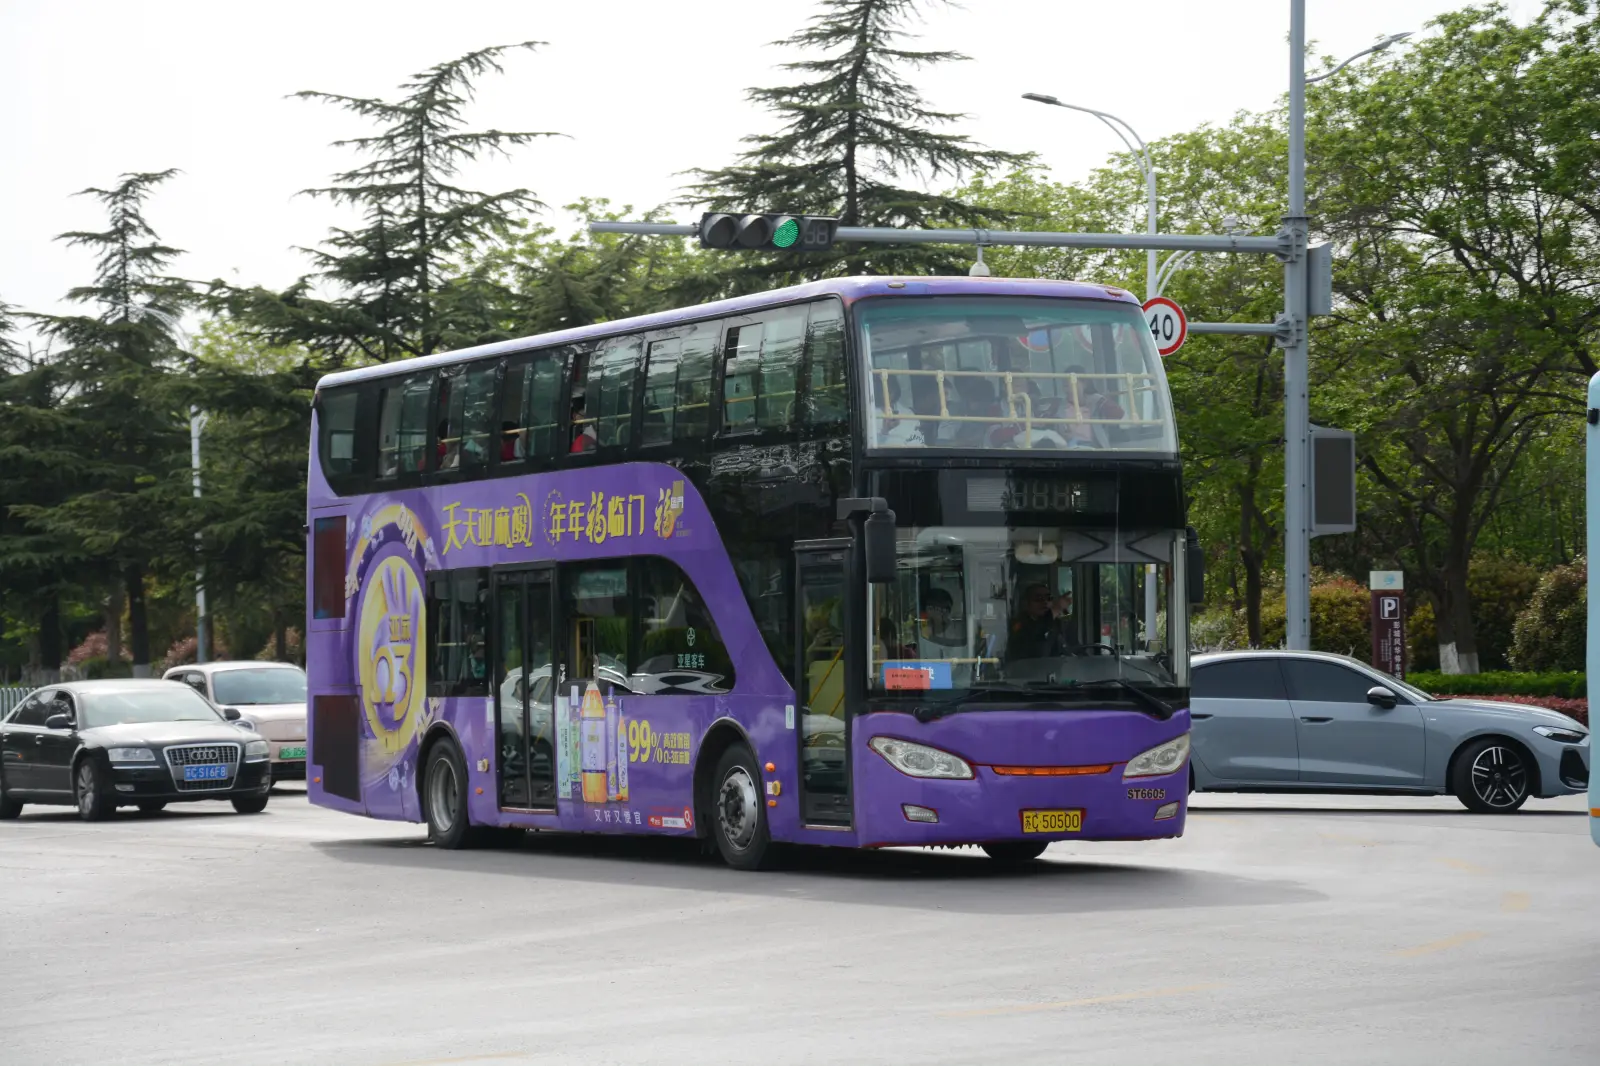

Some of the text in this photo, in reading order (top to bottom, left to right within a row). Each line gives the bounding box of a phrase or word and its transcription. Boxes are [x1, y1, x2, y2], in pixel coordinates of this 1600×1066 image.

[1150, 314, 1174, 341] 40
[442, 493, 533, 555] 天天亚麻酸
[1384, 599, 1396, 617] P
[677, 653, 705, 668] 亚星客车
[628, 719, 663, 764] 99%
[1127, 788, 1165, 800] ST6605
[593, 808, 642, 825] 又好又便宜
